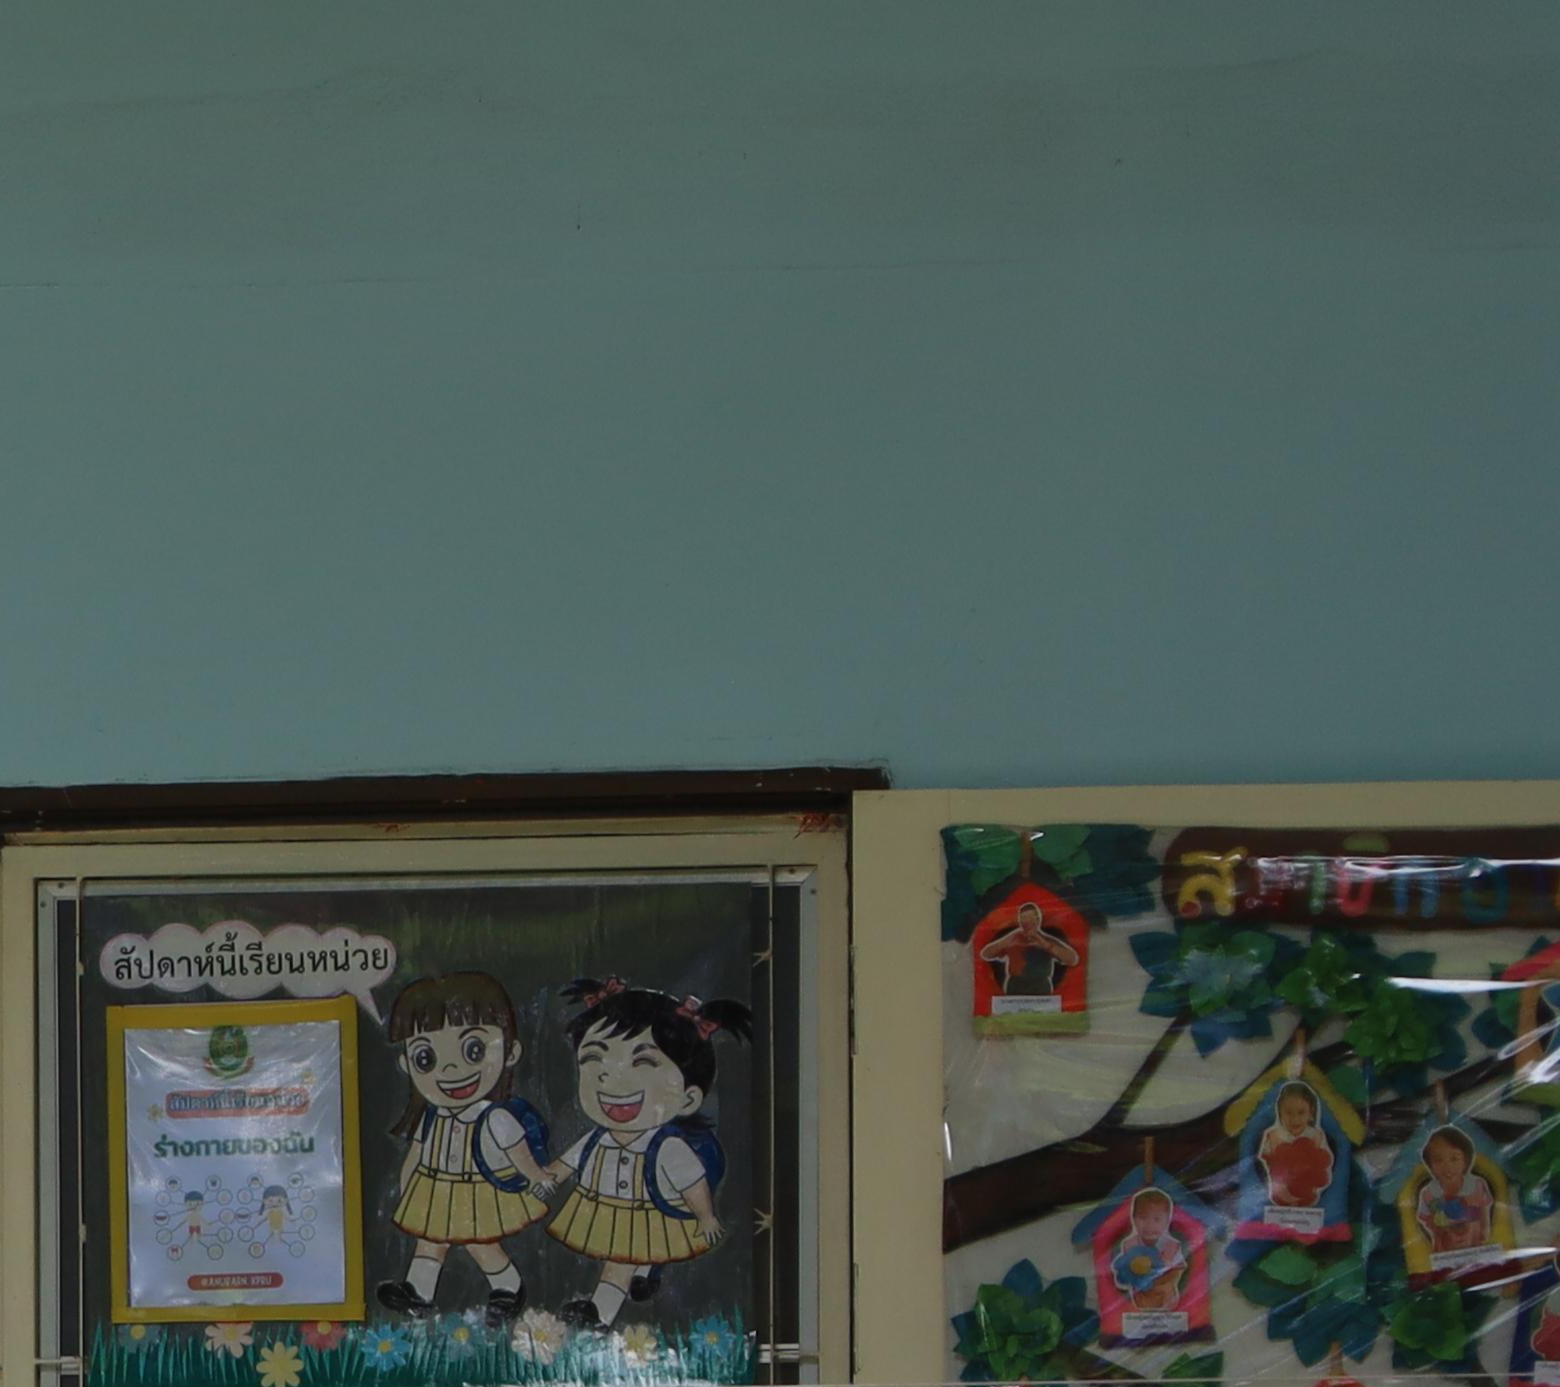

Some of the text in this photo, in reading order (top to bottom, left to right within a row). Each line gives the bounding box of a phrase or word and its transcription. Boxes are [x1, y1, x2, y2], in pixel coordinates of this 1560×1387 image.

[113, 931, 390, 981] สัปดาห์นี้เรียนหน่วย
[153, 1131, 315, 1158] ร่างกายของฉัน
